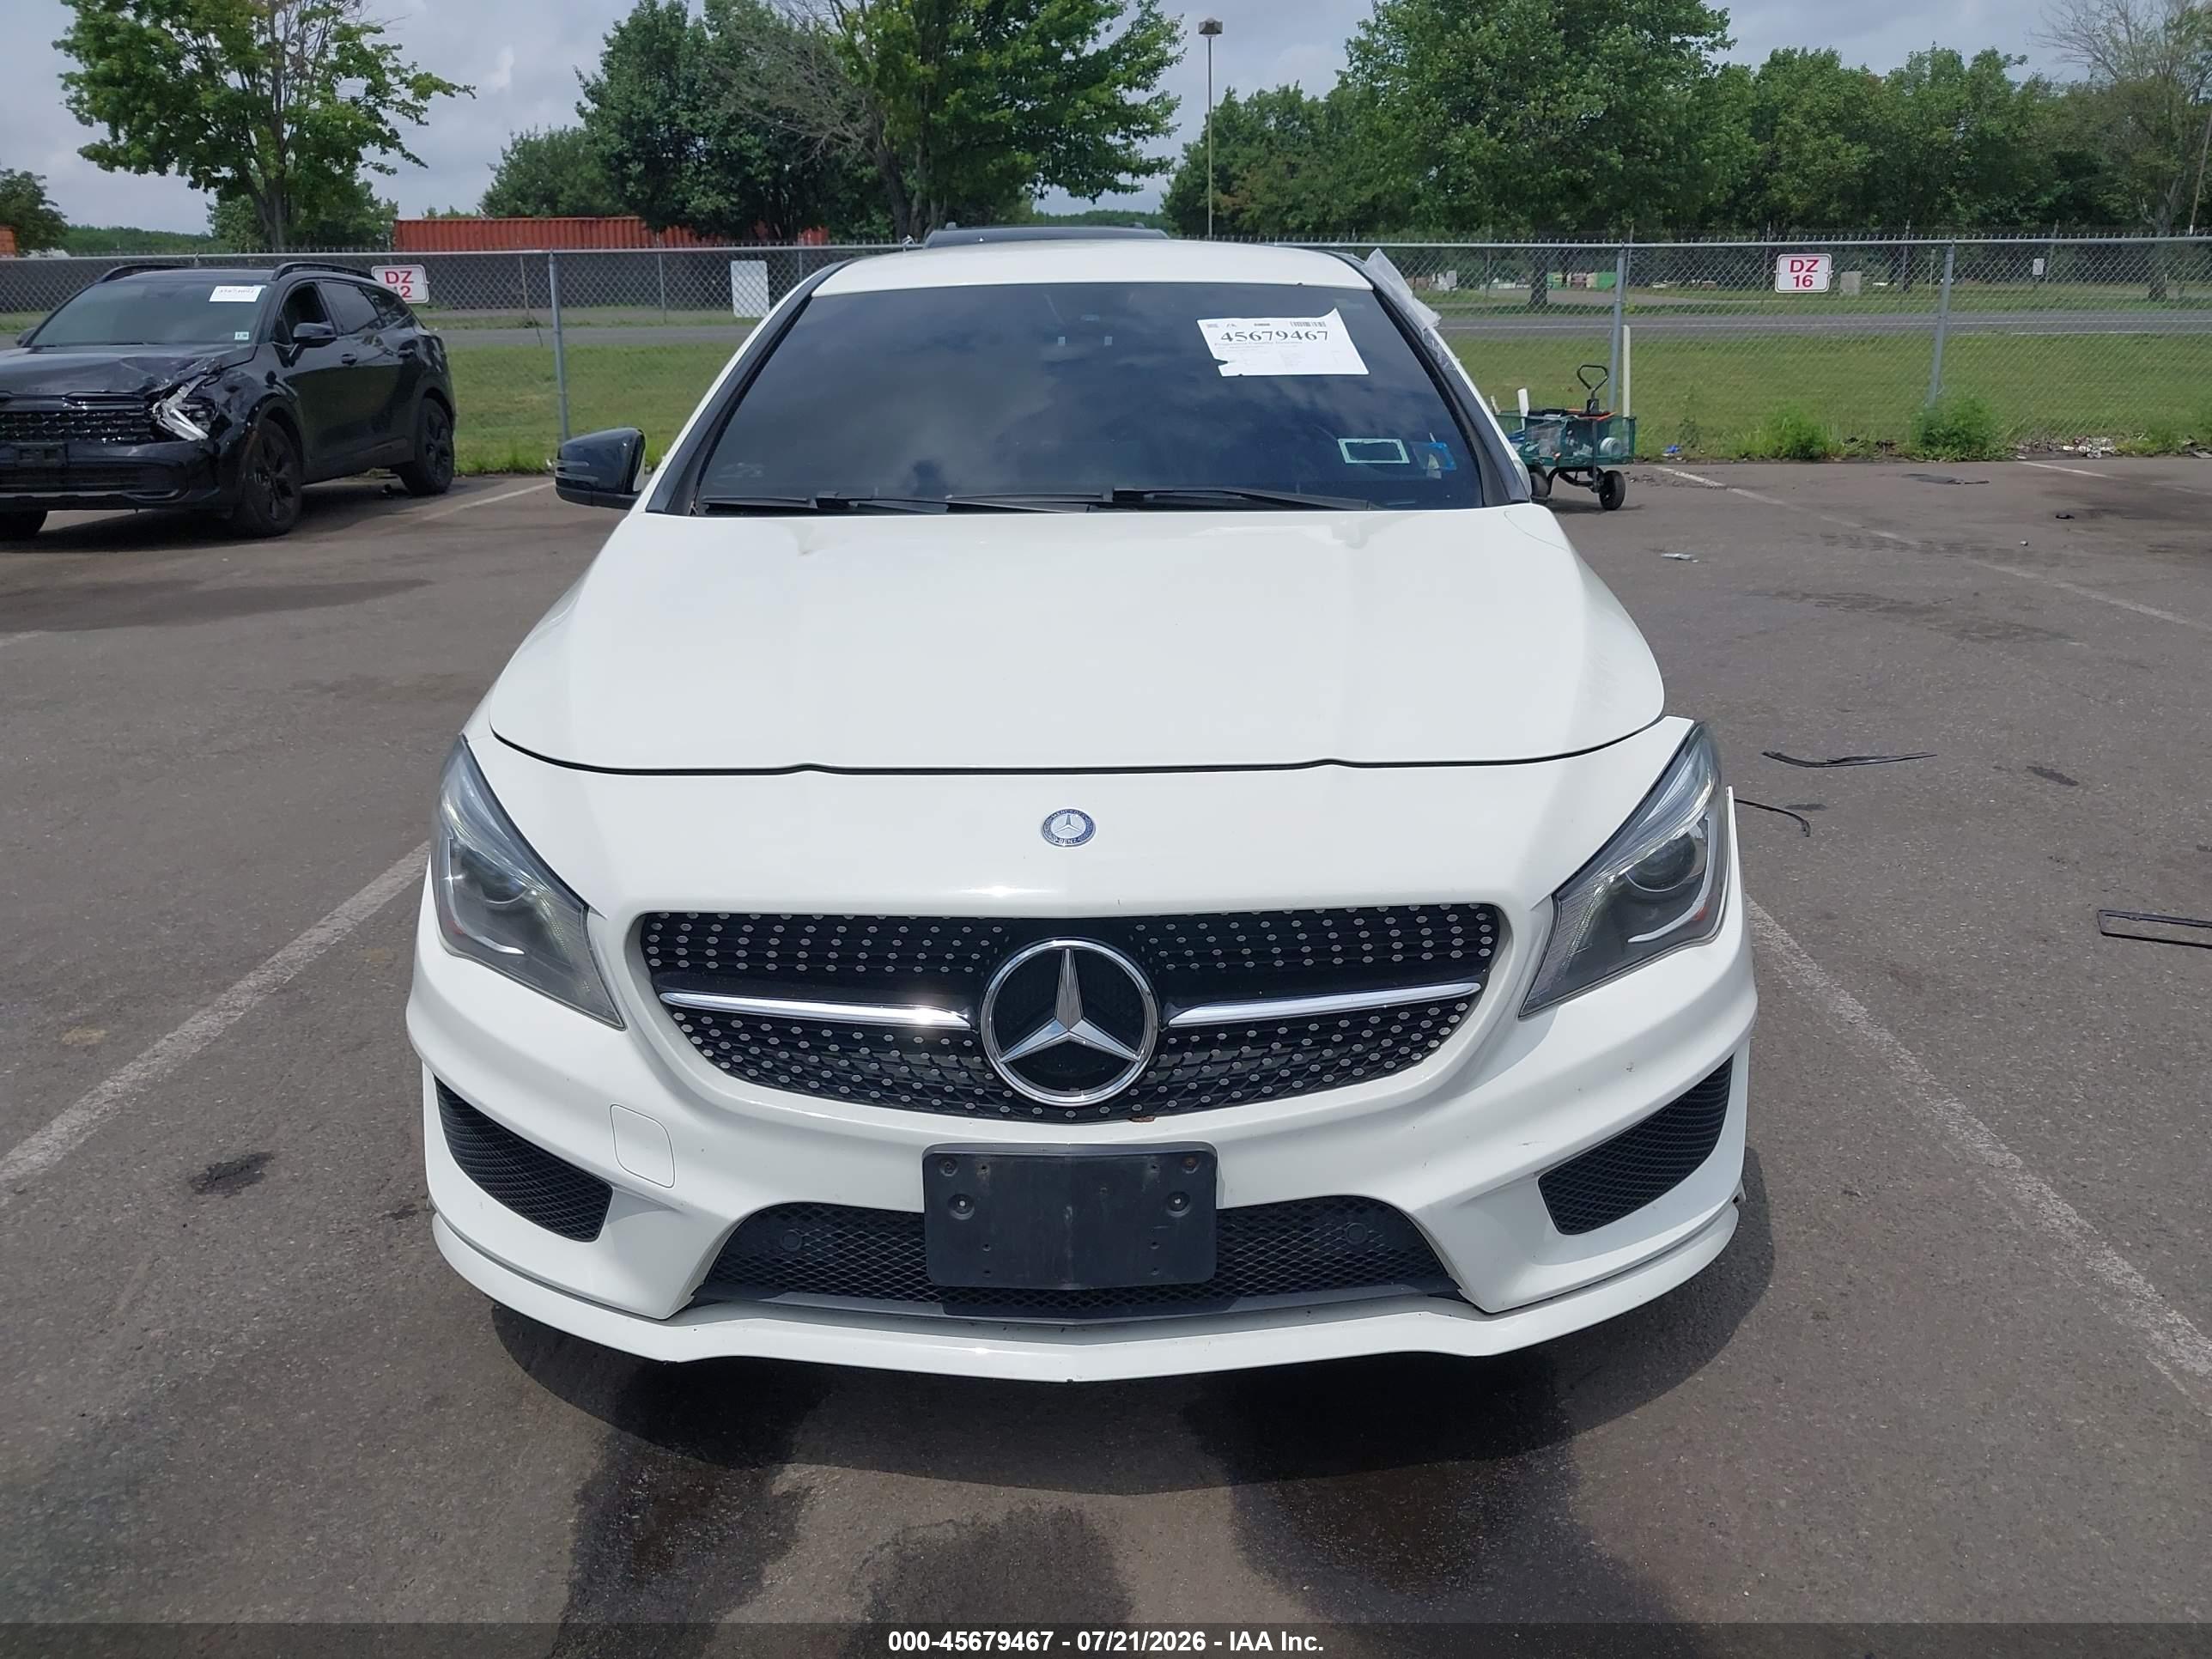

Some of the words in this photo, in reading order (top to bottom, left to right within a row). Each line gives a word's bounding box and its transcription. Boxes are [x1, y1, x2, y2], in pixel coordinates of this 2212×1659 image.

[1790, 259, 1820, 273] DZ
[385, 270, 414, 284] DZ
[1793, 274, 1814, 288] 16
[1220, 330, 1329, 343] 45679467
